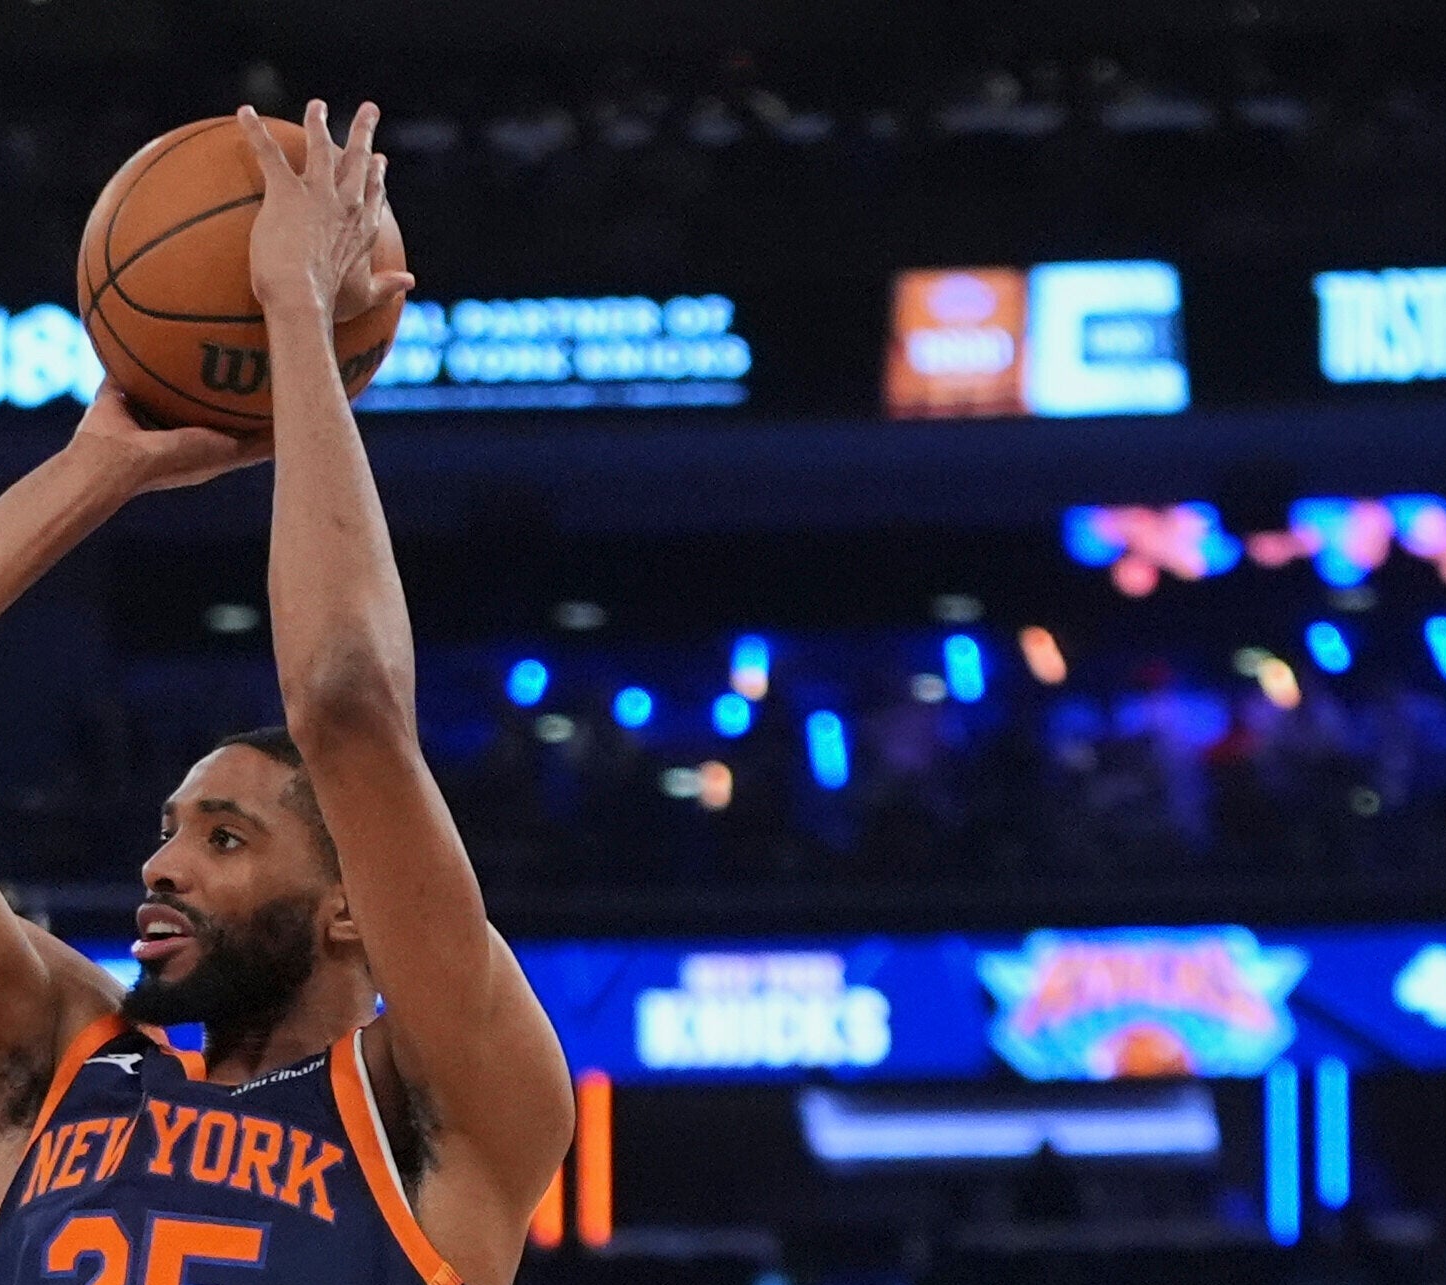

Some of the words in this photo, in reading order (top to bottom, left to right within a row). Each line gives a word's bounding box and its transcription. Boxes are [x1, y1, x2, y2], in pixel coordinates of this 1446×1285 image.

[635, 986, 892, 1069] KNICKS
[21, 1114, 138, 1207] NEW
[148, 1098, 346, 1224] YORK
